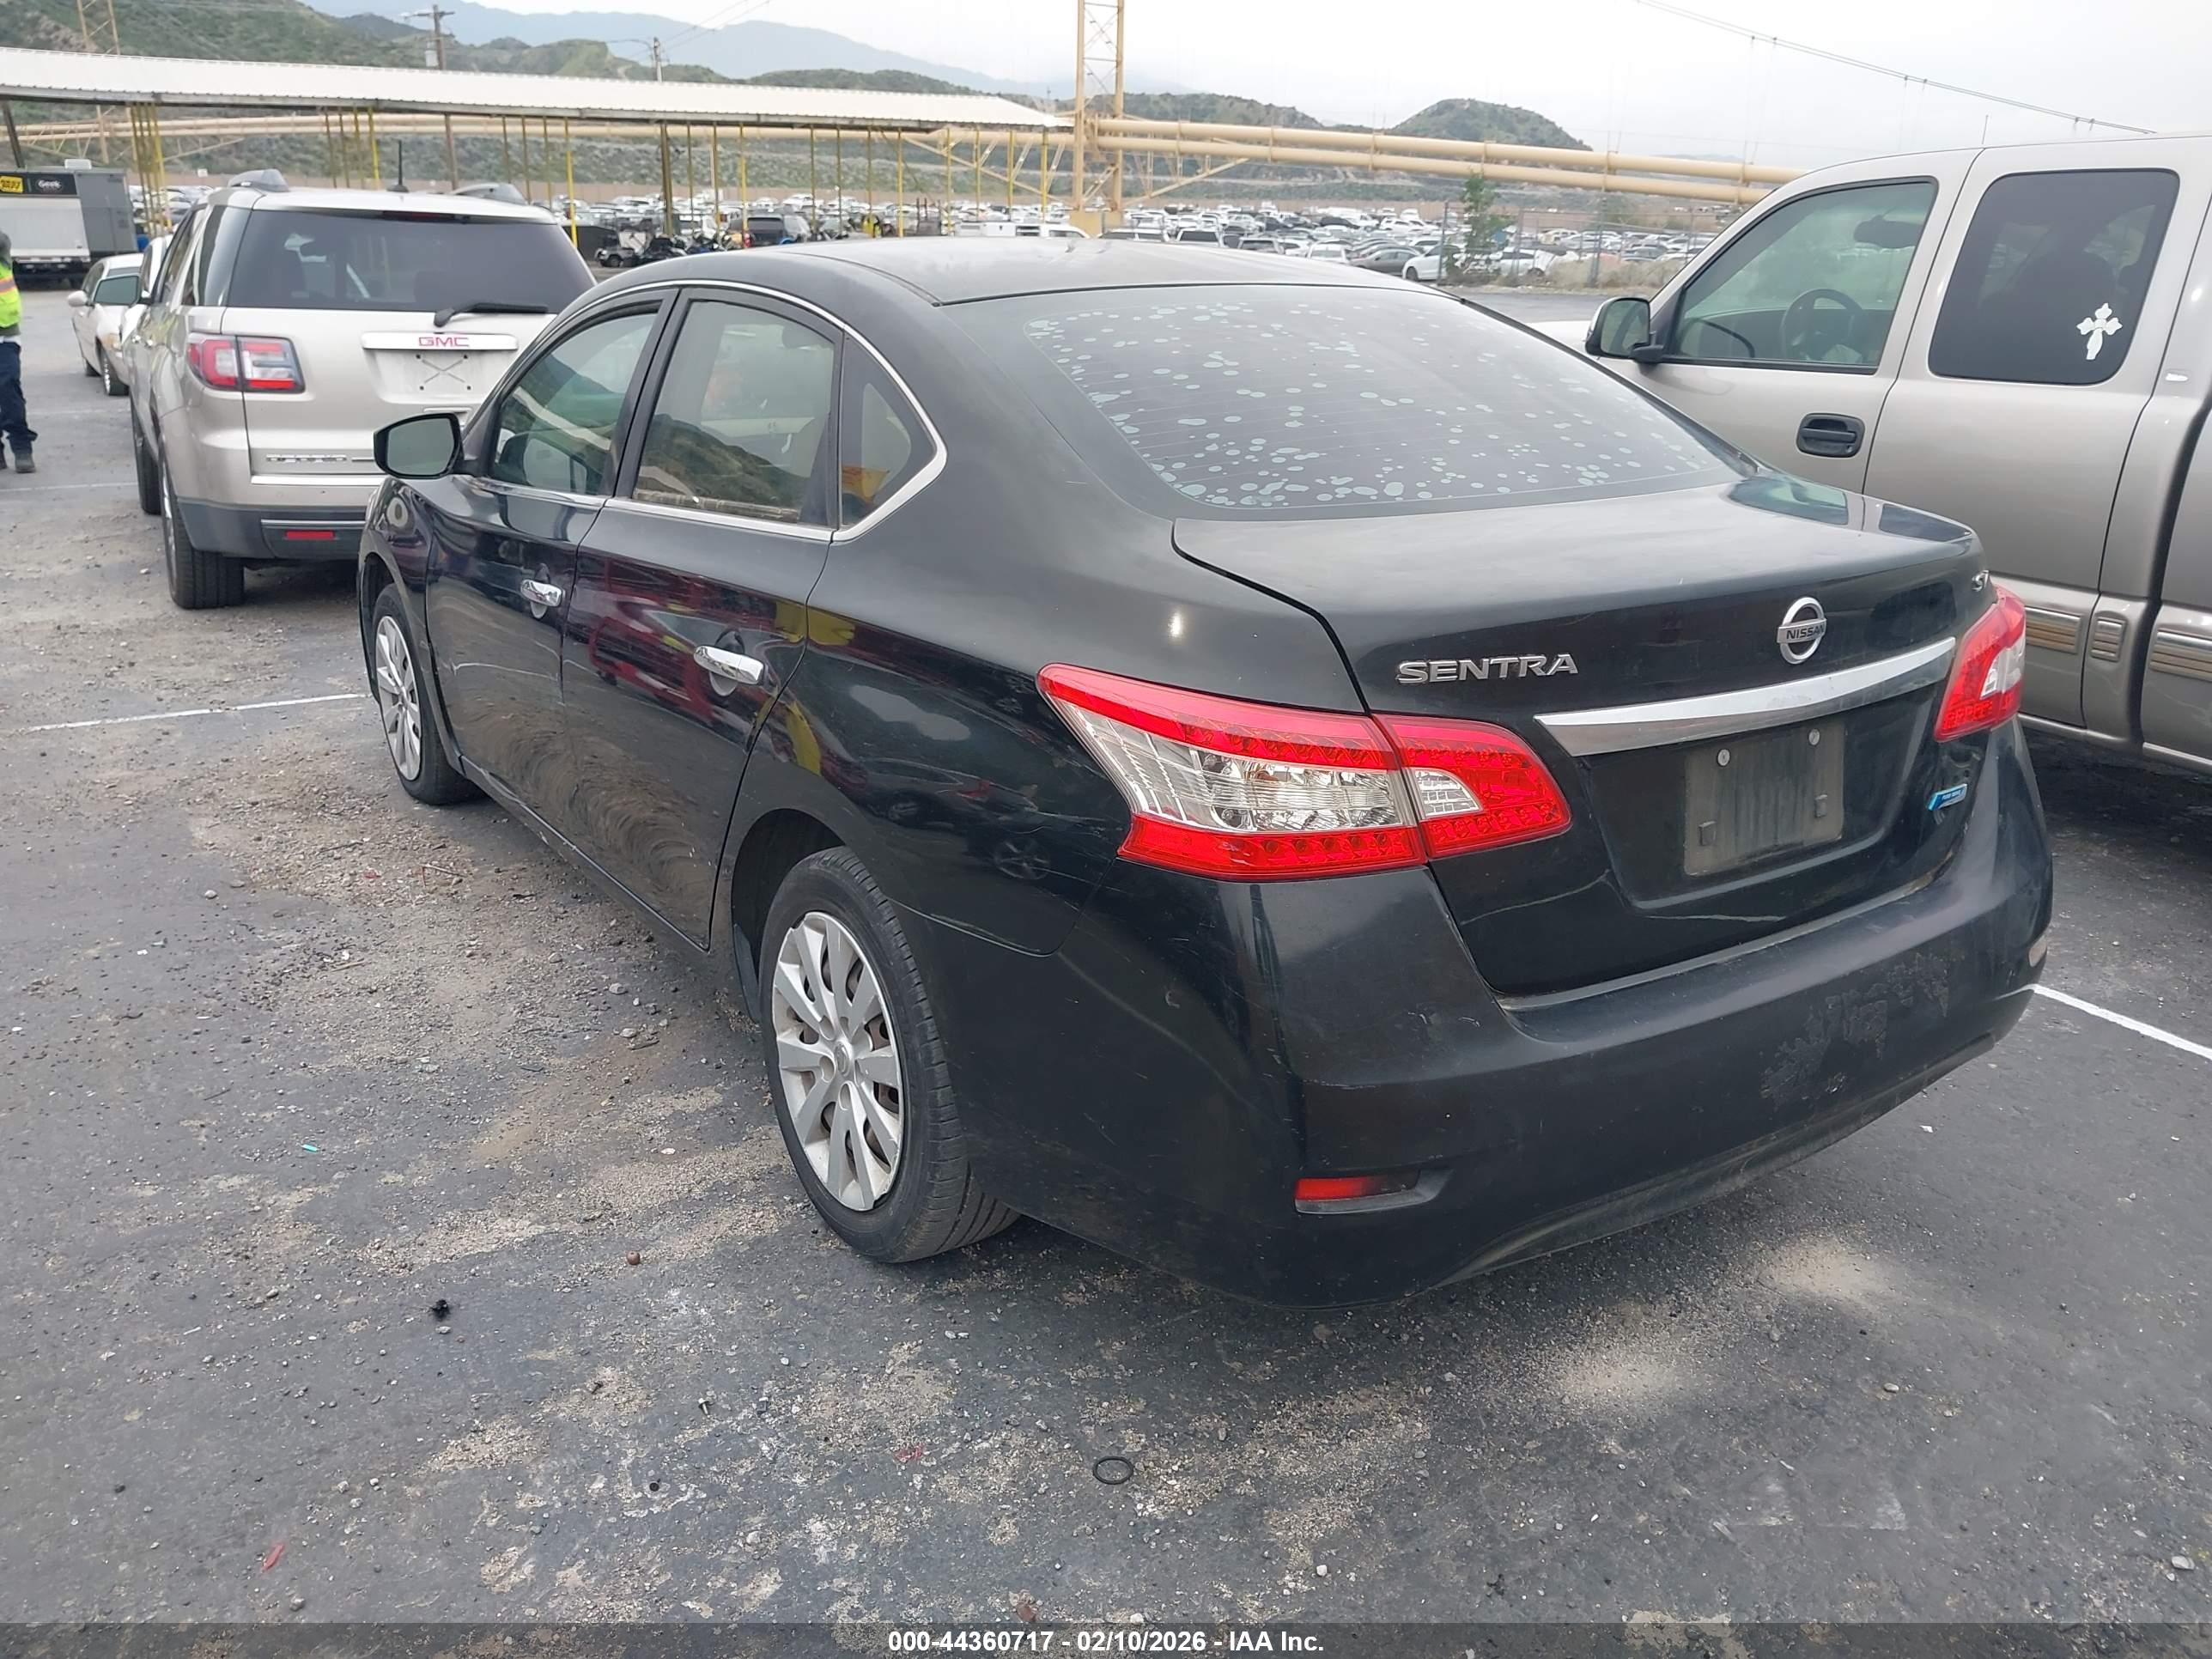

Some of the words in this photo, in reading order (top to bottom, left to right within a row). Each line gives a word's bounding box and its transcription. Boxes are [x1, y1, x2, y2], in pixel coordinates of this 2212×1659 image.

[418, 337, 469, 347] GMC
[1786, 624, 1825, 640] NISSAN
[1395, 653, 1578, 684] SENTRA
